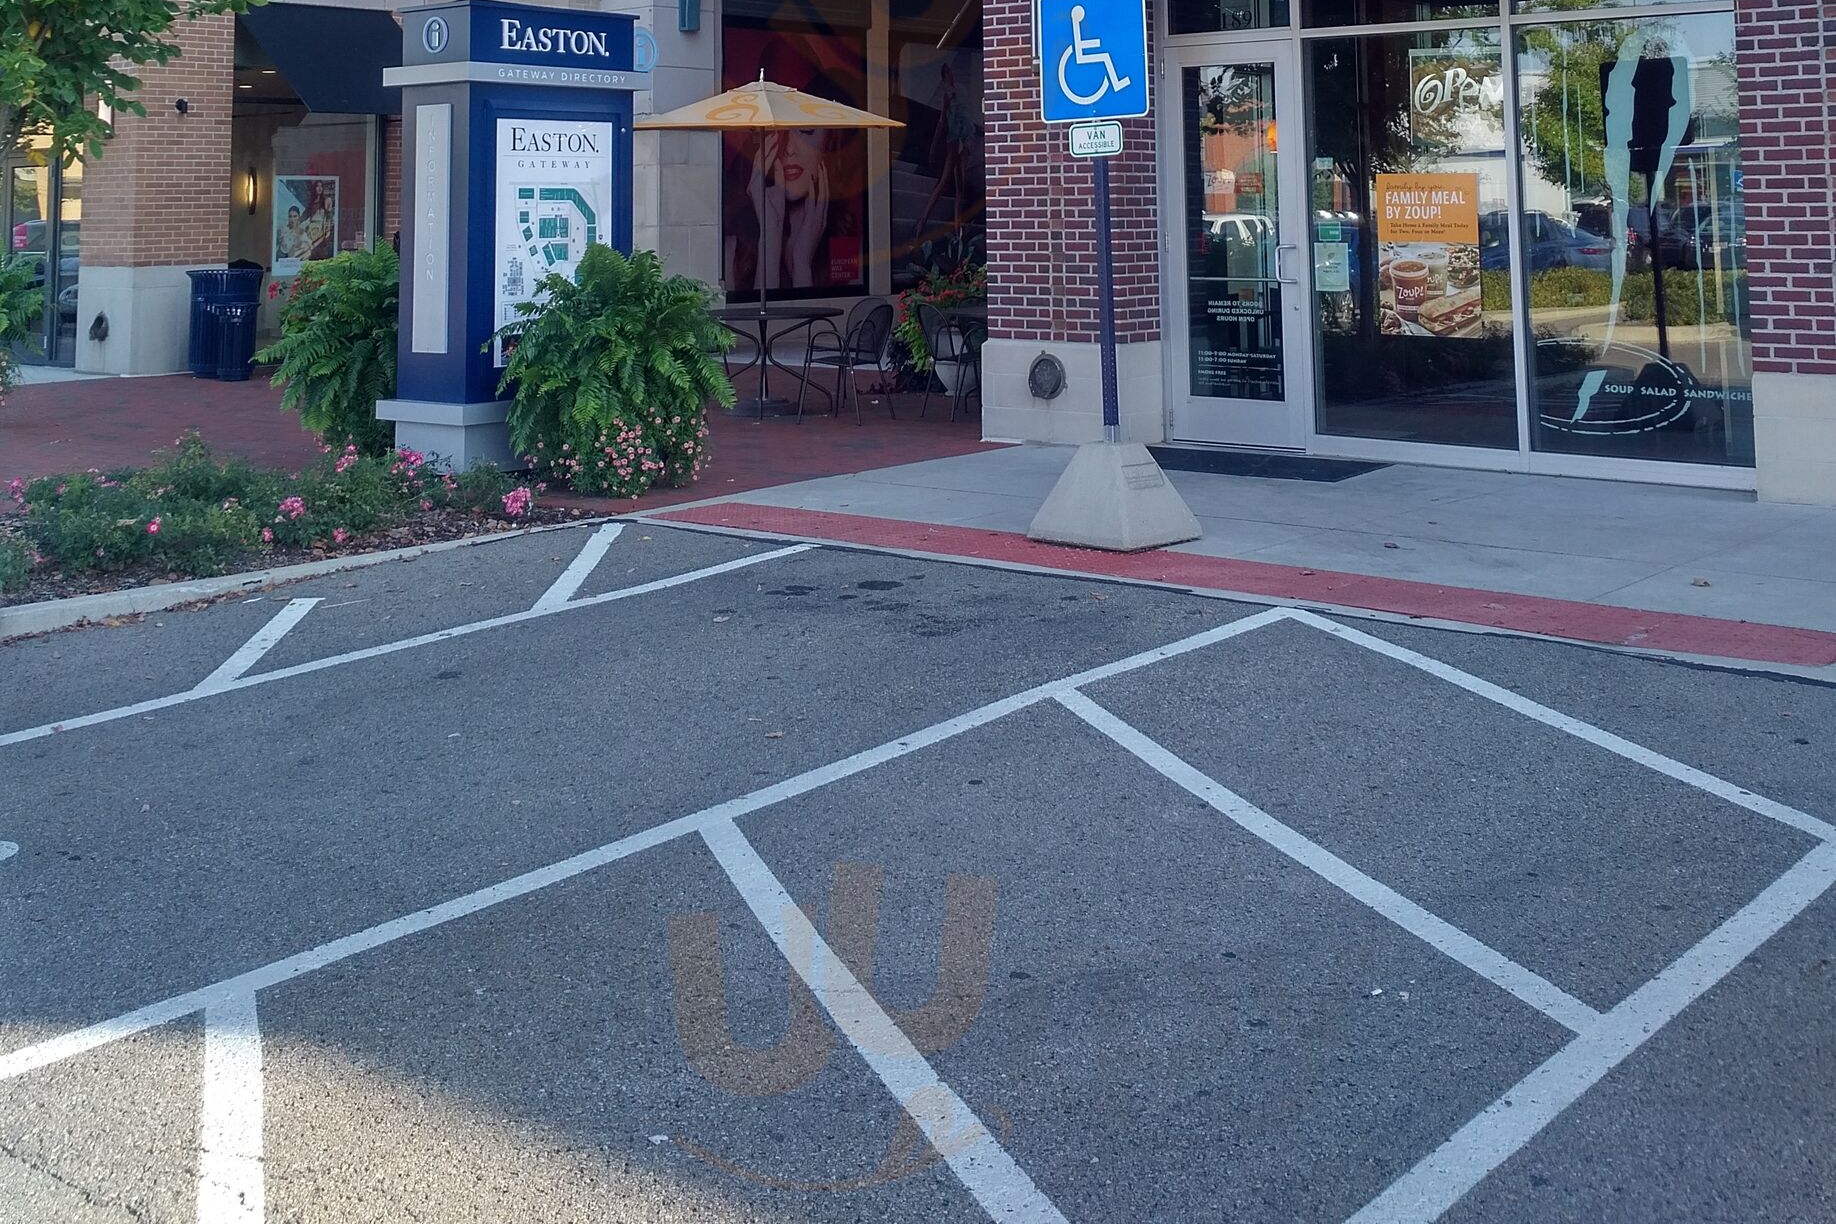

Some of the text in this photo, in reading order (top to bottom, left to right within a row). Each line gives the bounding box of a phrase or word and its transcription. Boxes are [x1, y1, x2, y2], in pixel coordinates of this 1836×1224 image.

[498, 68, 626, 84] GATEWAY DIRECTORY
[1086, 129, 1106, 140] VAN
[1078, 140, 1115, 150] ACCESSIBLE
[517, 160, 591, 169] GATEWAY
[425, 114, 437, 281] INFORMATION
[1385, 190, 1466, 205] FAMILY MEAL
[1386, 205, 1442, 219] BY ZOUP!
[1604, 384, 1752, 401] SOUP SALAD SANDWICHE
